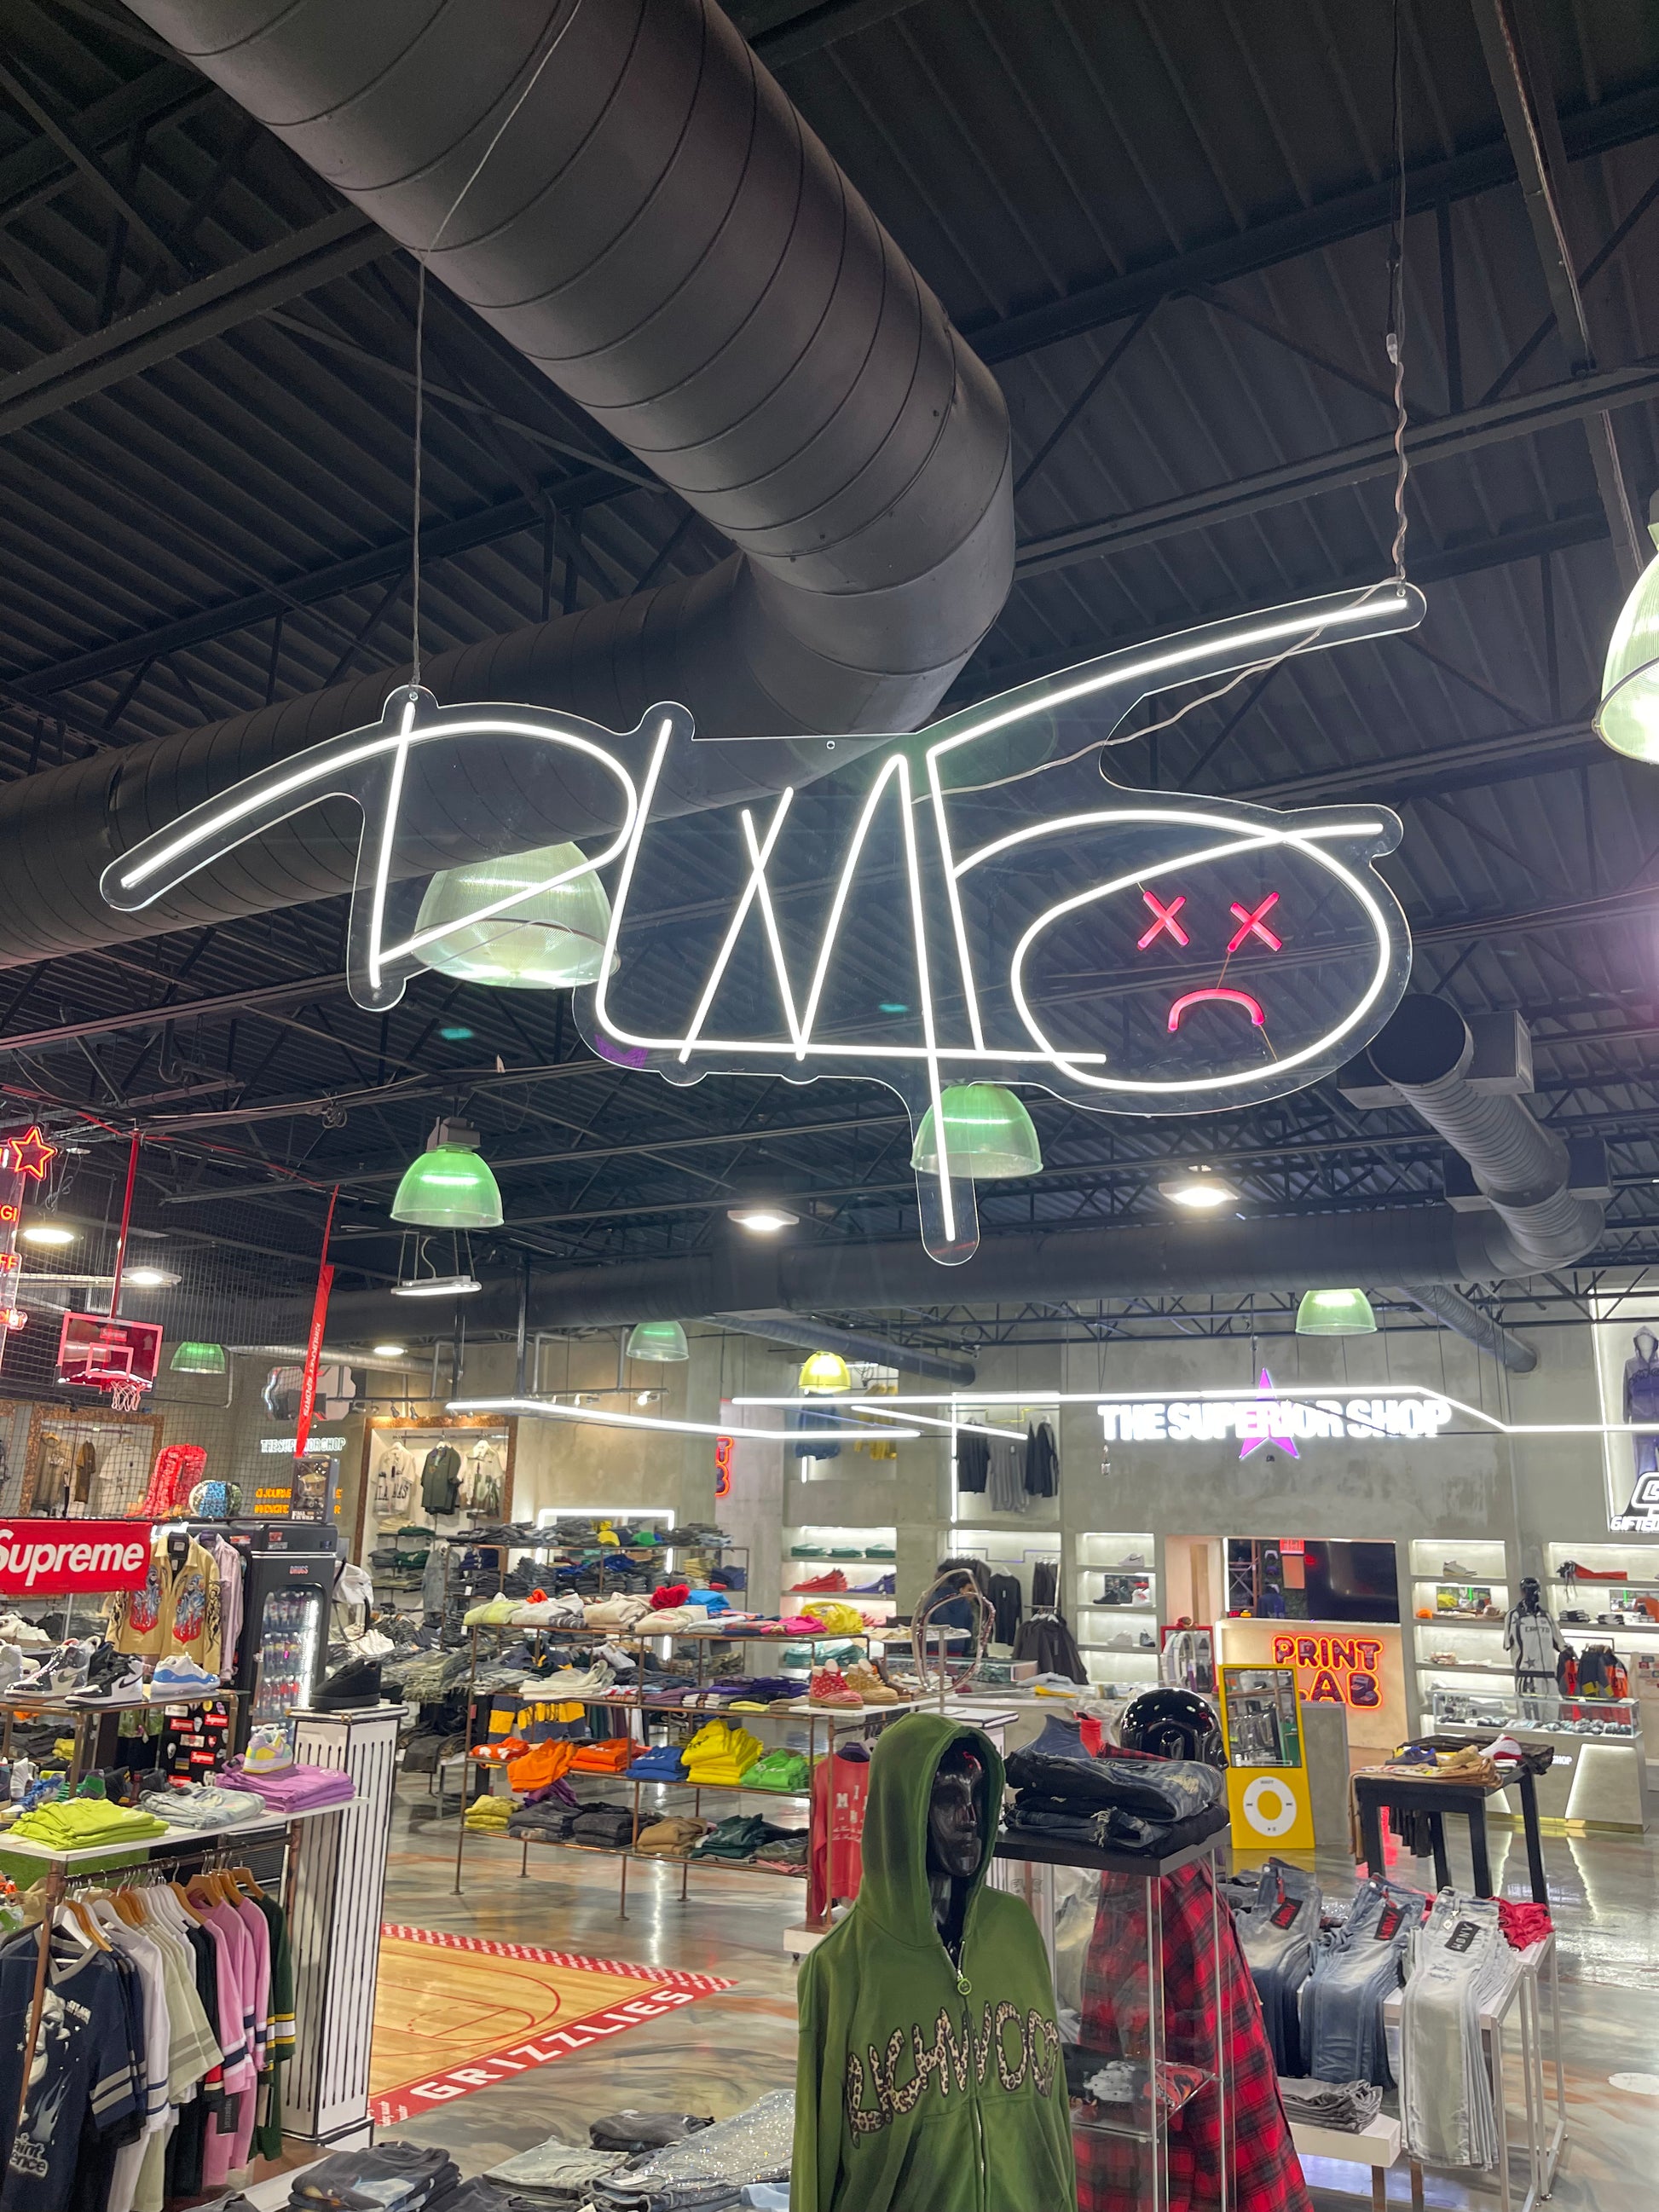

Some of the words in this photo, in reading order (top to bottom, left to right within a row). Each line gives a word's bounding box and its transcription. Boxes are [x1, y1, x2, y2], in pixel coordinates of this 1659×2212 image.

[1097, 1403, 1166, 1441] THE
[1167, 1401, 1344, 1440] SUPERIOR
[1345, 1399, 1451, 1438] SHOP
[0, 1529, 144, 1586] Supreme
[1272, 1635, 1384, 1672] PRINT
[1298, 1668, 1383, 1709] AB
[409, 1990, 694, 2099] GRIZZLIES
